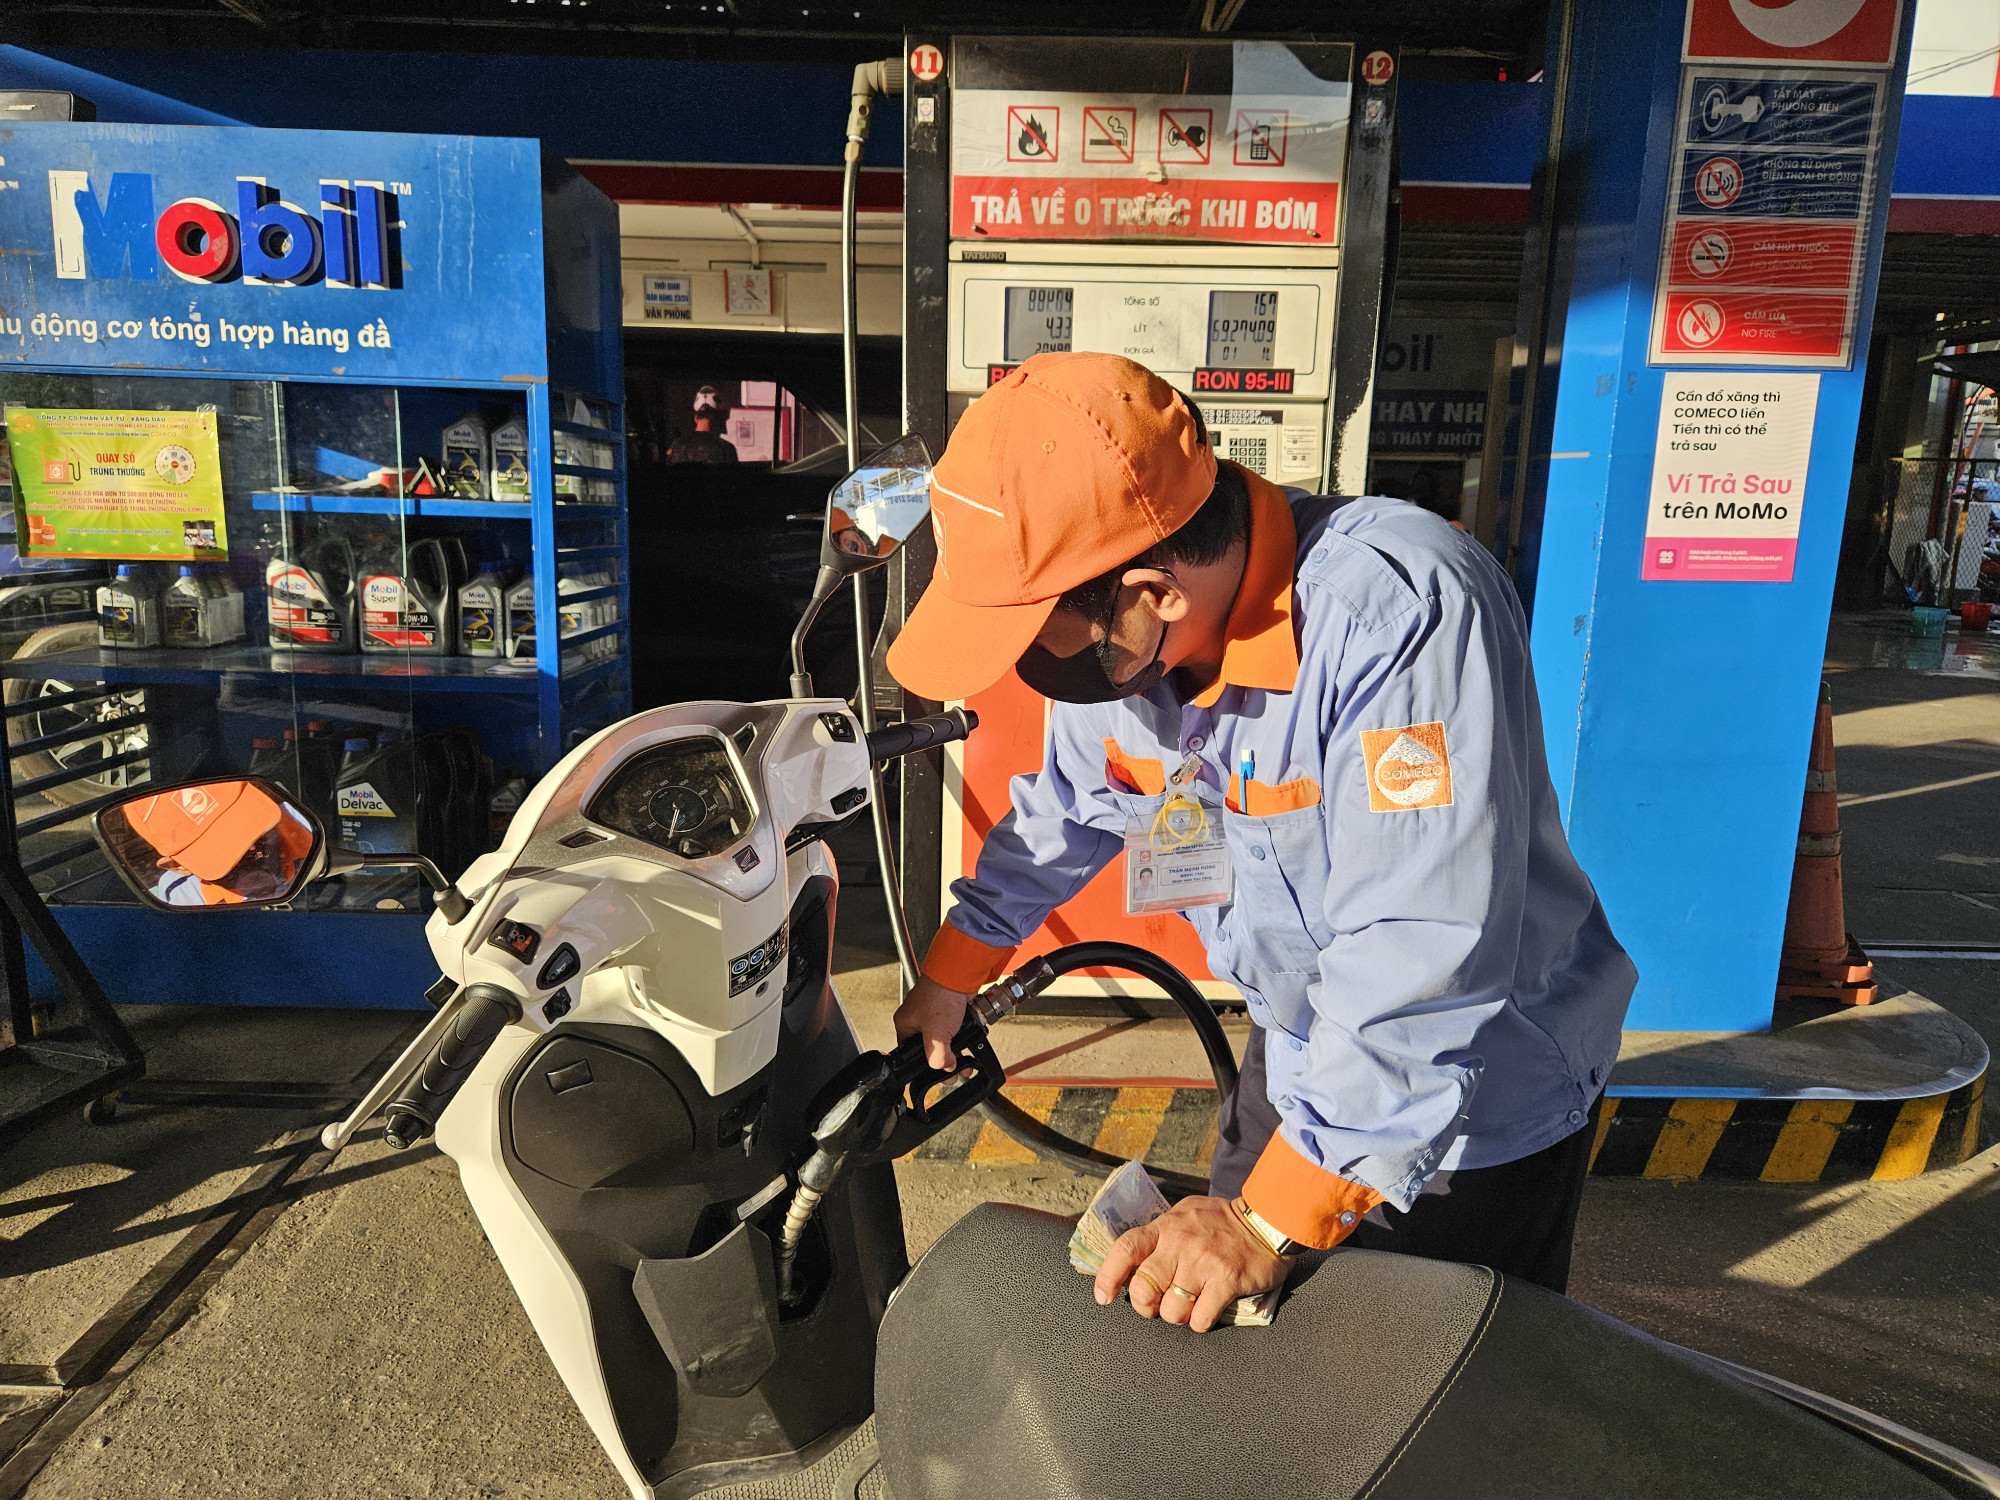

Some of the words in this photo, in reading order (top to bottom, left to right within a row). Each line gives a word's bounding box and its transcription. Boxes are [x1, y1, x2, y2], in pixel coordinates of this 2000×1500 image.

[913, 51, 939, 74] 11
[1363, 57, 1391, 79] 12
[971, 188, 1023, 224] TRẢ
[1031, 187, 1066, 225] VỀ
[1201, 199, 1247, 228] KHI
[1255, 197, 1318, 230] BƠM
[48, 170, 385, 290] Mobil
[963, 252, 1005, 260] TATSUNO
[1750, 261, 1766, 270] NO
[31, 313, 98, 343] động
[107, 319, 142, 338] cơ
[219, 318, 274, 350] hợp
[283, 321, 349, 352] hàng
[1741, 329, 1757, 338] NO
[1759, 329, 1778, 338] FIRE
[1195, 371, 1240, 390] RON
[1245, 372, 1292, 391] 95-III
[1705, 389, 1724, 402] đổ
[1727, 391, 1760, 404] xăng
[1763, 391, 1781, 402] thì
[1216, 410, 1261, 418] 01:2025/SP
[1674, 407, 1738, 418] COMECO
[1216, 417, 1275, 425] 01:2025/PVOIL
[1704, 424, 1722, 435] thì
[1725, 424, 1741, 435] có
[1745, 422, 1768, 435] thể
[1671, 440, 1690, 450] trả
[1693, 442, 1717, 450] sau
[96, 453, 119, 464] QUAY
[123, 450, 136, 463] SỐ
[89, 467, 115, 476] TRÚNG
[117, 467, 146, 477] THƯỞNG
[1667, 473, 1694, 493] Ví
[1698, 473, 1737, 494] Trả
[1743, 474, 1793, 494] Sau
[1664, 502, 1709, 519] trên
[1715, 502, 1788, 519] MoMo
[280, 581, 307, 590] Mobil
[371, 584, 398, 594] Mobil
[371, 594, 398, 604] Super
[403, 614, 428, 623] 20W-50
[1381, 765, 1443, 780] COMECO
[350, 790, 373, 798] Mobil
[341, 798, 383, 810] Delvac
